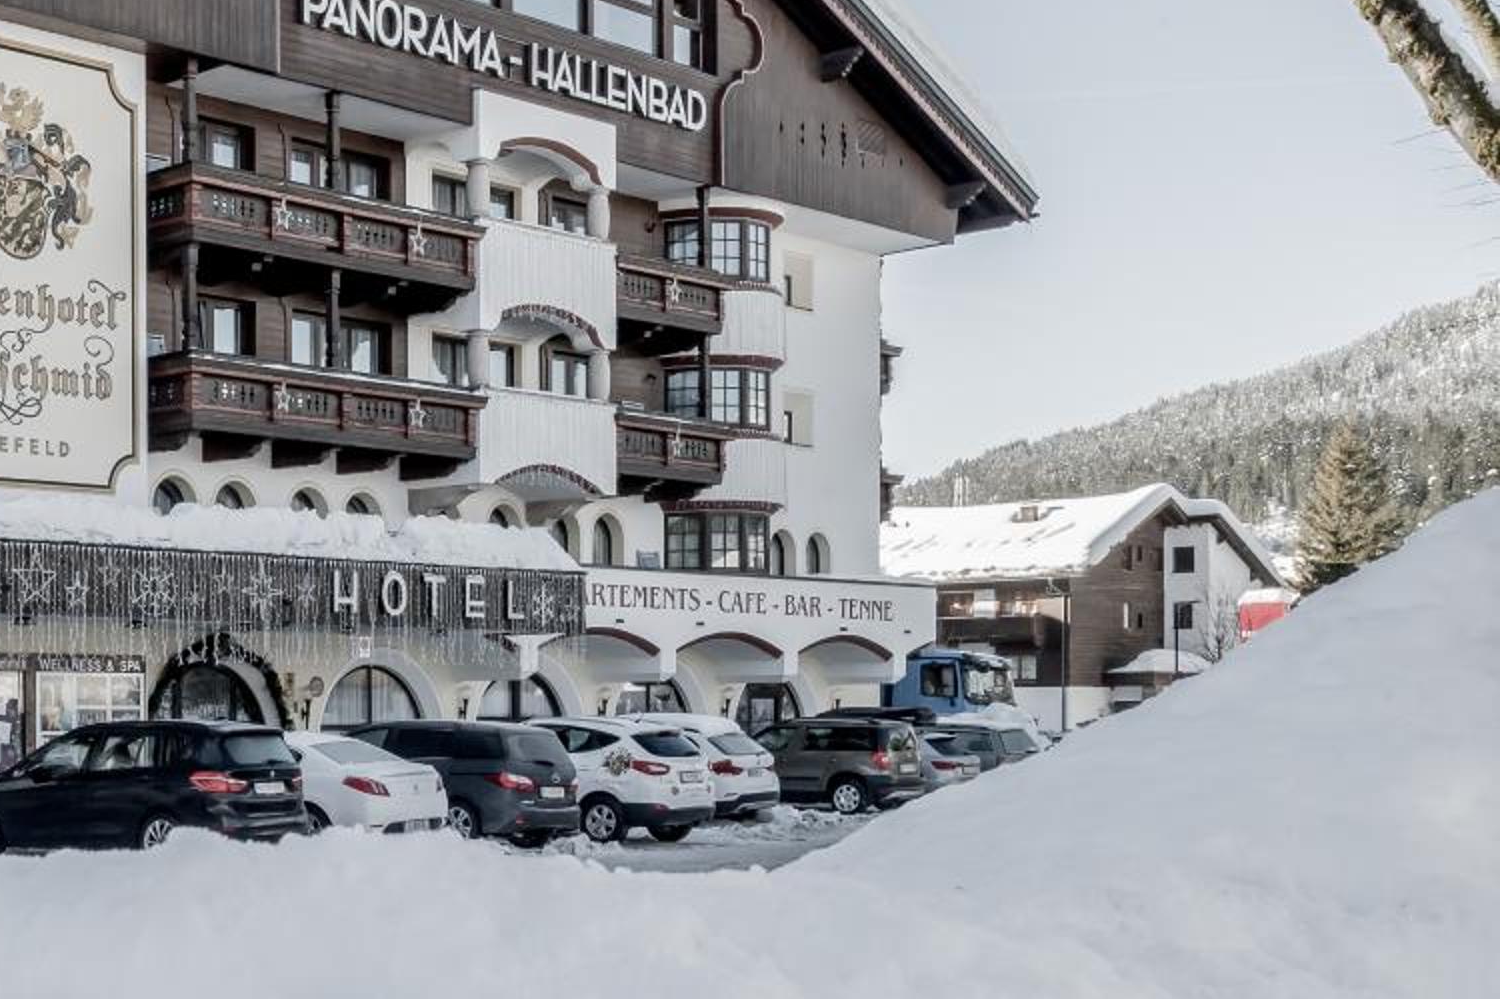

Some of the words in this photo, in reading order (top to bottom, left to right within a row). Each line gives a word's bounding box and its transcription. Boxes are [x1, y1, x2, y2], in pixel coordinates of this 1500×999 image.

[333, 568, 525, 620] HOTEL
[718, 590, 767, 615] CAFE
[784, 594, 822, 618] BAR
[839, 598, 894, 622] TENNE
[39, 658, 101, 672] WELLNESS
[106, 660, 115, 672] &
[120, 660, 142, 672] SPA
